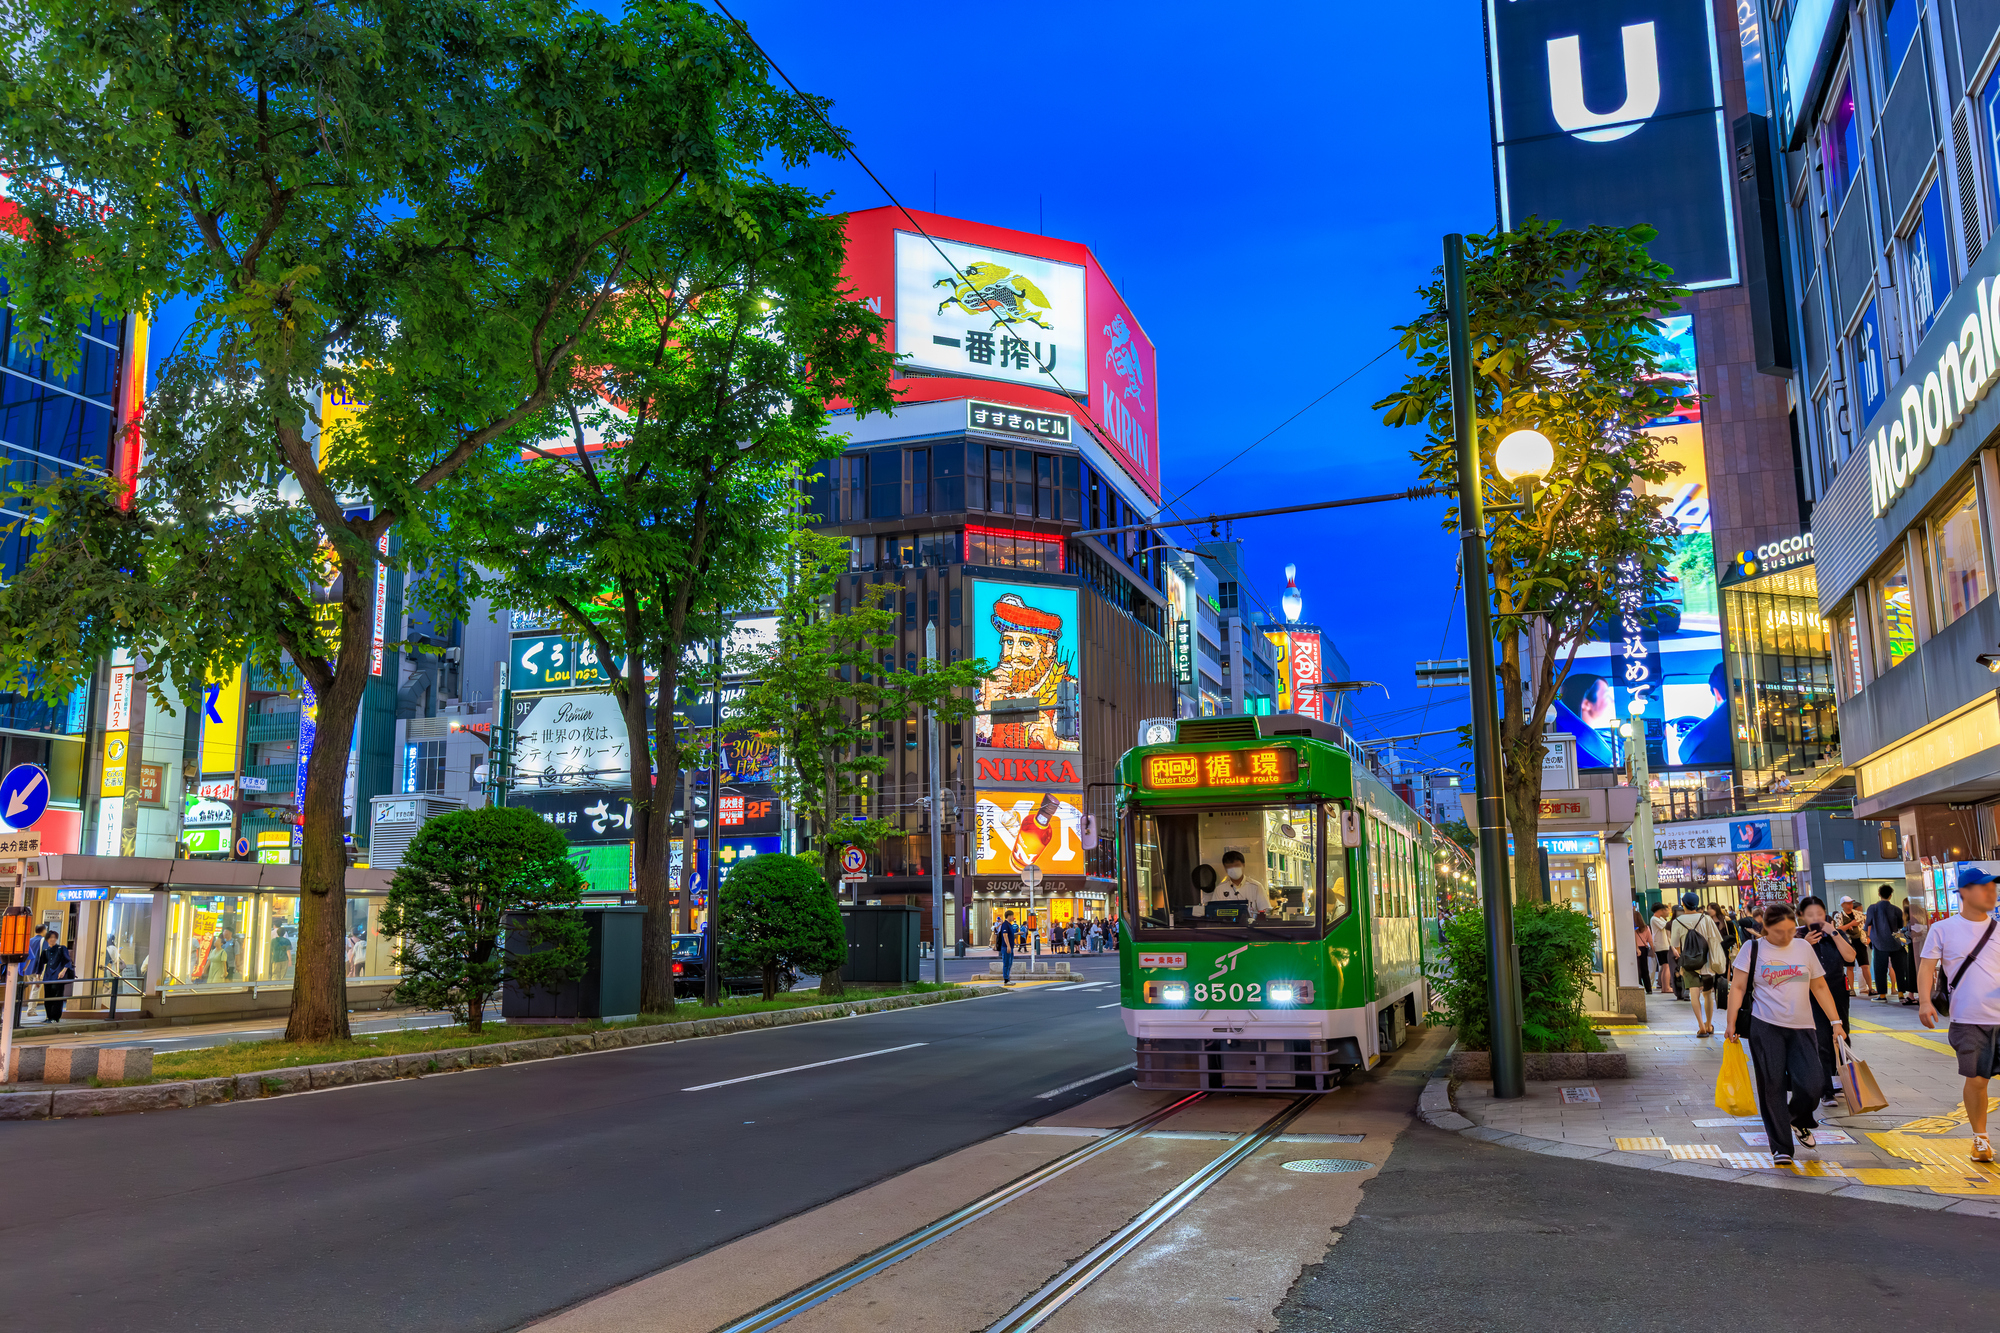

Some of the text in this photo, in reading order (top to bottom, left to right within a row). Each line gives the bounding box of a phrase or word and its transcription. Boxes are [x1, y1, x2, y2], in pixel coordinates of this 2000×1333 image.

[932, 330, 1057, 374] 一番搾り
[974, 409, 1065, 436] すすきのビル
[1103, 380, 1150, 477] KIRIN
[1178, 623, 1191, 682] すすきのビル
[112, 672, 124, 728] ほっとハウス
[516, 702, 531, 715] 9F
[552, 702, 594, 723] Premier
[976, 757, 1081, 783] NIKKA
[1154, 759, 1195, 777] 内回り
[1206, 753, 1279, 778] 循環
[242, 777, 266, 786] すすきの
[1154, 776, 1197, 784] Inner loop
[1209, 774, 1279, 785] Circular route
[747, 801, 772, 818] 2F
[986, 805, 995, 841] NIKKA
[976, 805, 985, 860] FRONTIER
[1551, 840, 1578, 853] TOWN
[1656, 835, 1727, 851] 24時まで営業中
[68, 890, 97, 899] POLE TOWN
[1044, 881, 1068, 891] BLD.
[1758, 880, 1788, 892] 北海道
[1158, 956, 1183, 964] 乗降中
[1194, 983, 1262, 1002] 8502
